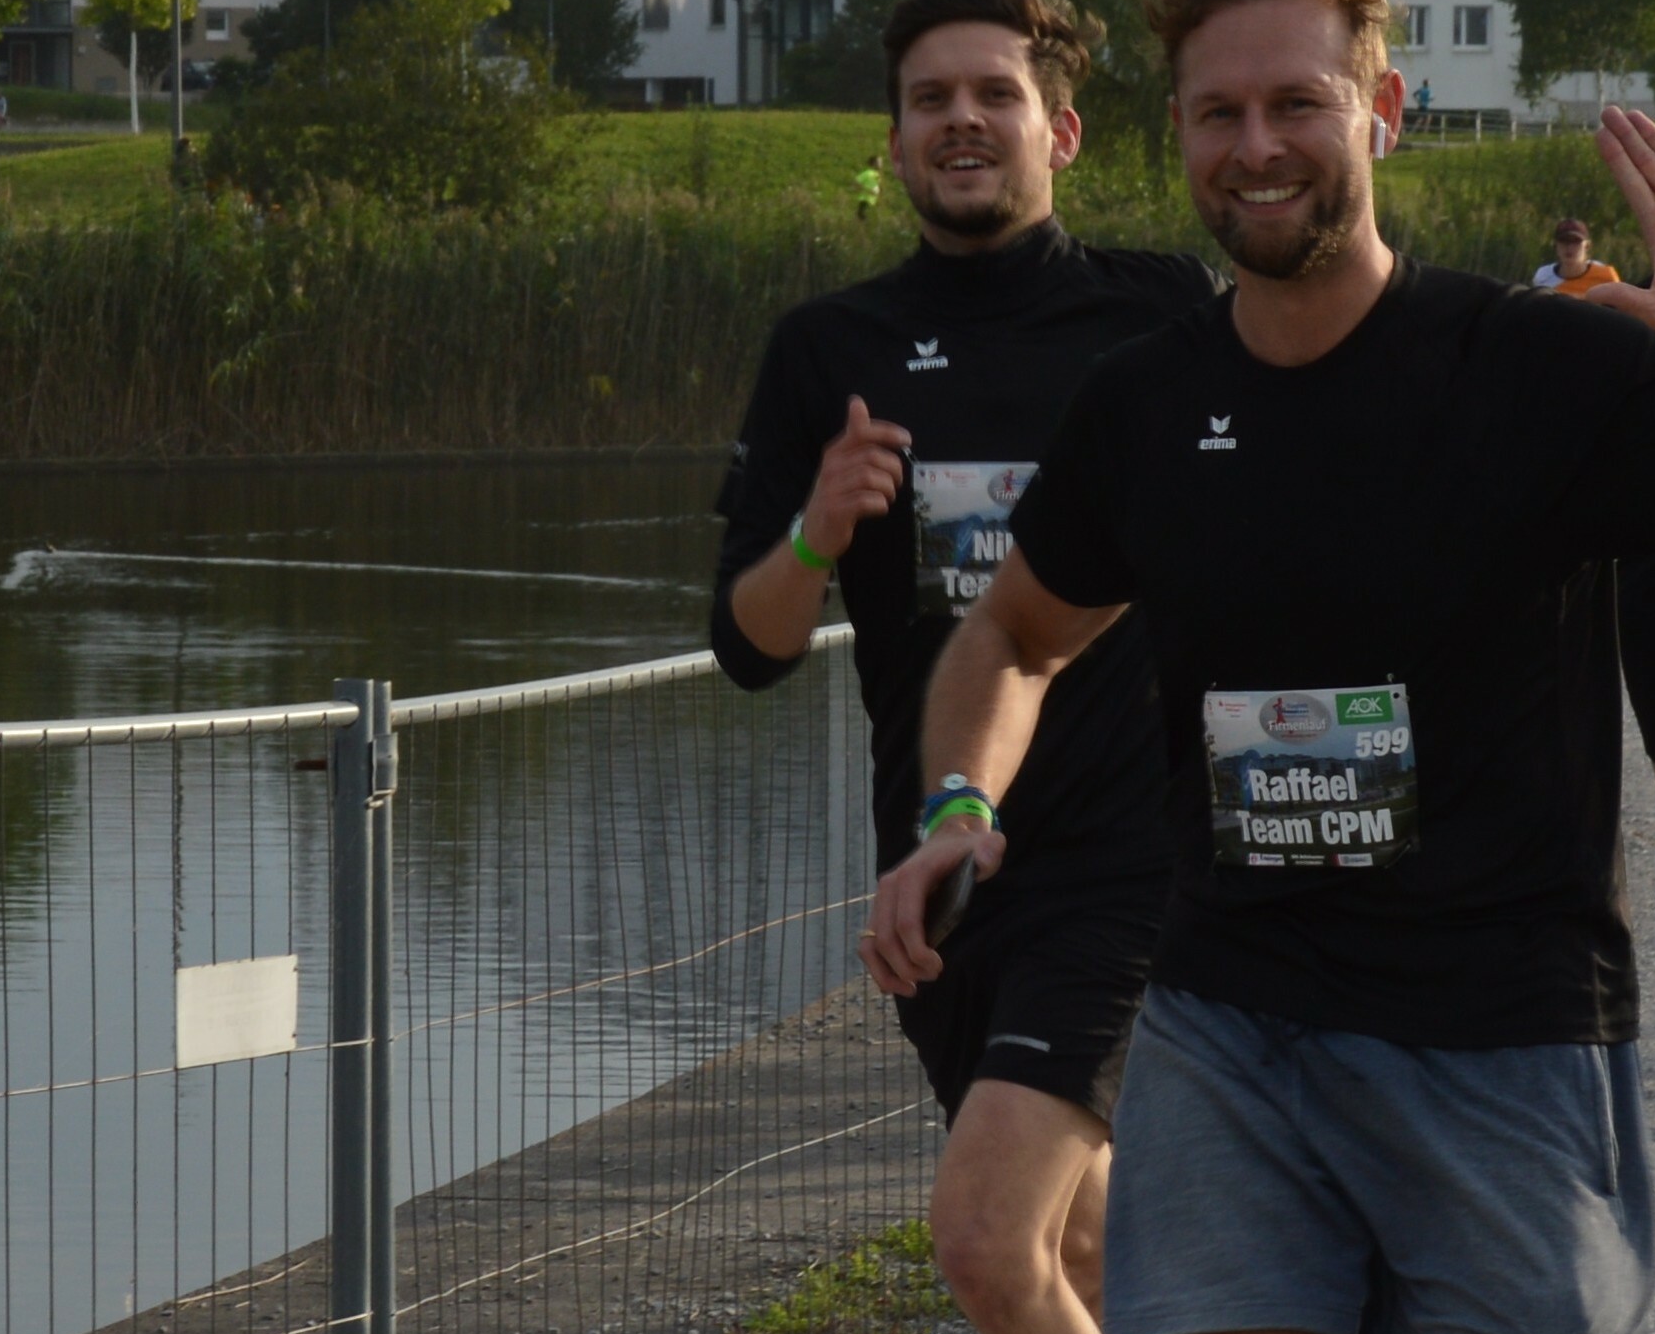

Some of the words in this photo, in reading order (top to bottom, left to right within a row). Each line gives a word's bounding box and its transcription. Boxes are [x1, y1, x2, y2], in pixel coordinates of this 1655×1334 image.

[906, 356, 948, 371] erima
[1198, 436, 1237, 450] erima
[1346, 697, 1383, 714] AOK
[1268, 718, 1326, 732] Firmenlauf
[1355, 727, 1410, 758] 599
[1248, 768, 1358, 803] Raffael
[1236, 810, 1314, 845] Team
[1320, 808, 1394, 845] CPM
